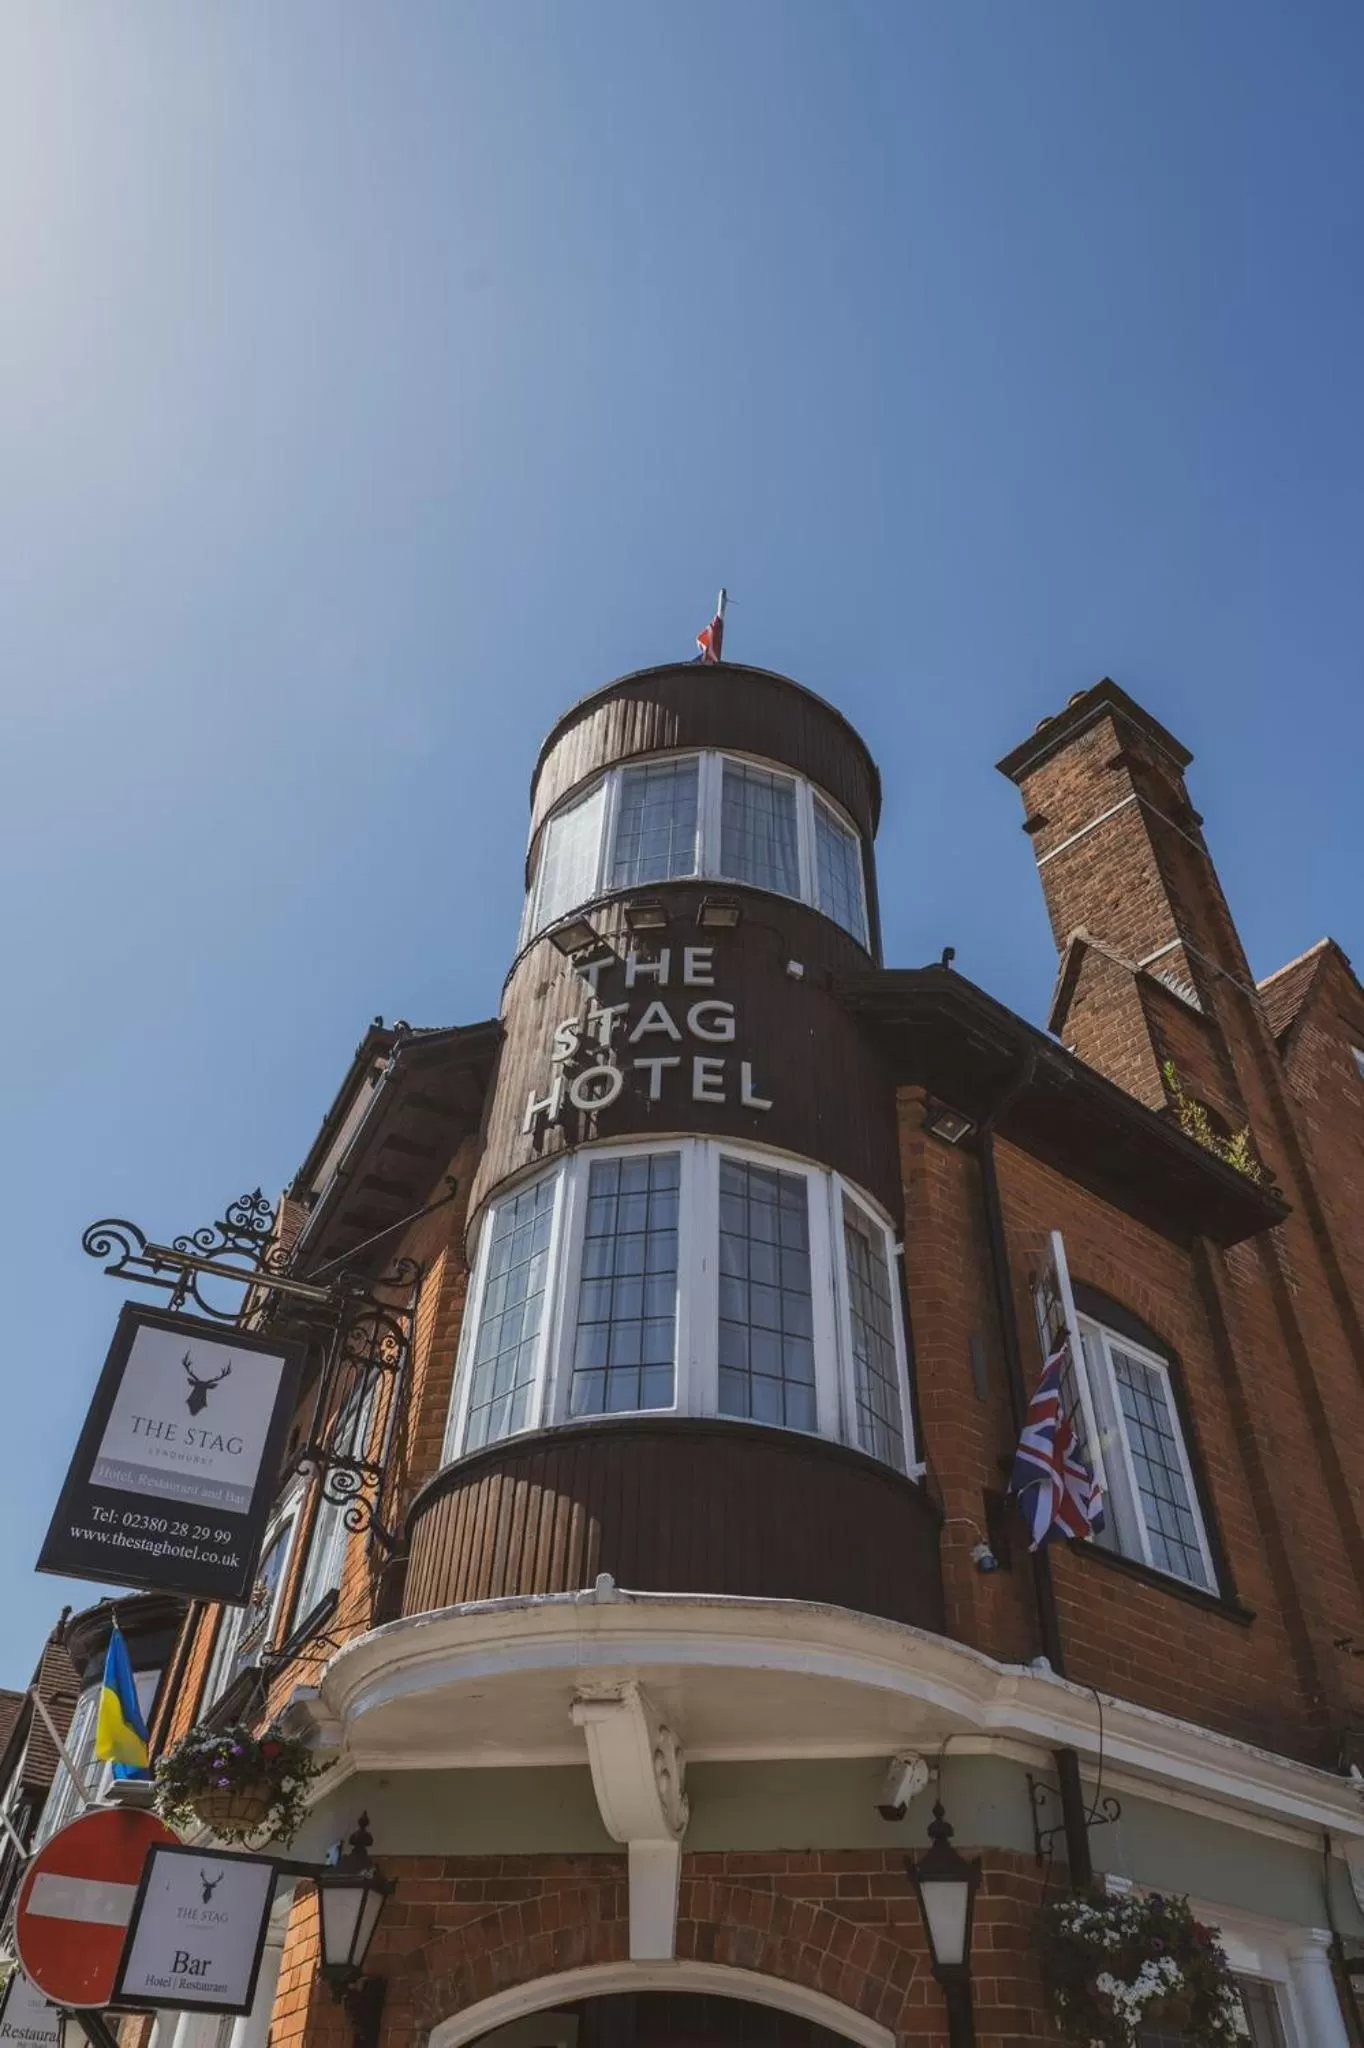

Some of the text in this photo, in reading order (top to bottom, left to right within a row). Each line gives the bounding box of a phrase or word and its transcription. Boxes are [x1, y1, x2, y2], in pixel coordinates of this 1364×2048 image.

[576, 947, 715, 992] THE
[552, 1000, 736, 1063] STAG
[522, 1056, 773, 1134] HOTEL
[131, 1415, 243, 1455] THE STAG
[201, 1484, 222, 1500] and
[91, 1506, 232, 1545] Tel: 02380 28 29 99
[70, 1525, 240, 1568] www.thestaghotel.co.uk
[176, 1907, 229, 1923] THE STAG
[170, 1950, 212, 1977] Bar
[145, 1974, 171, 1987] Hotel
[178, 1977, 228, 1993] Restaurant
